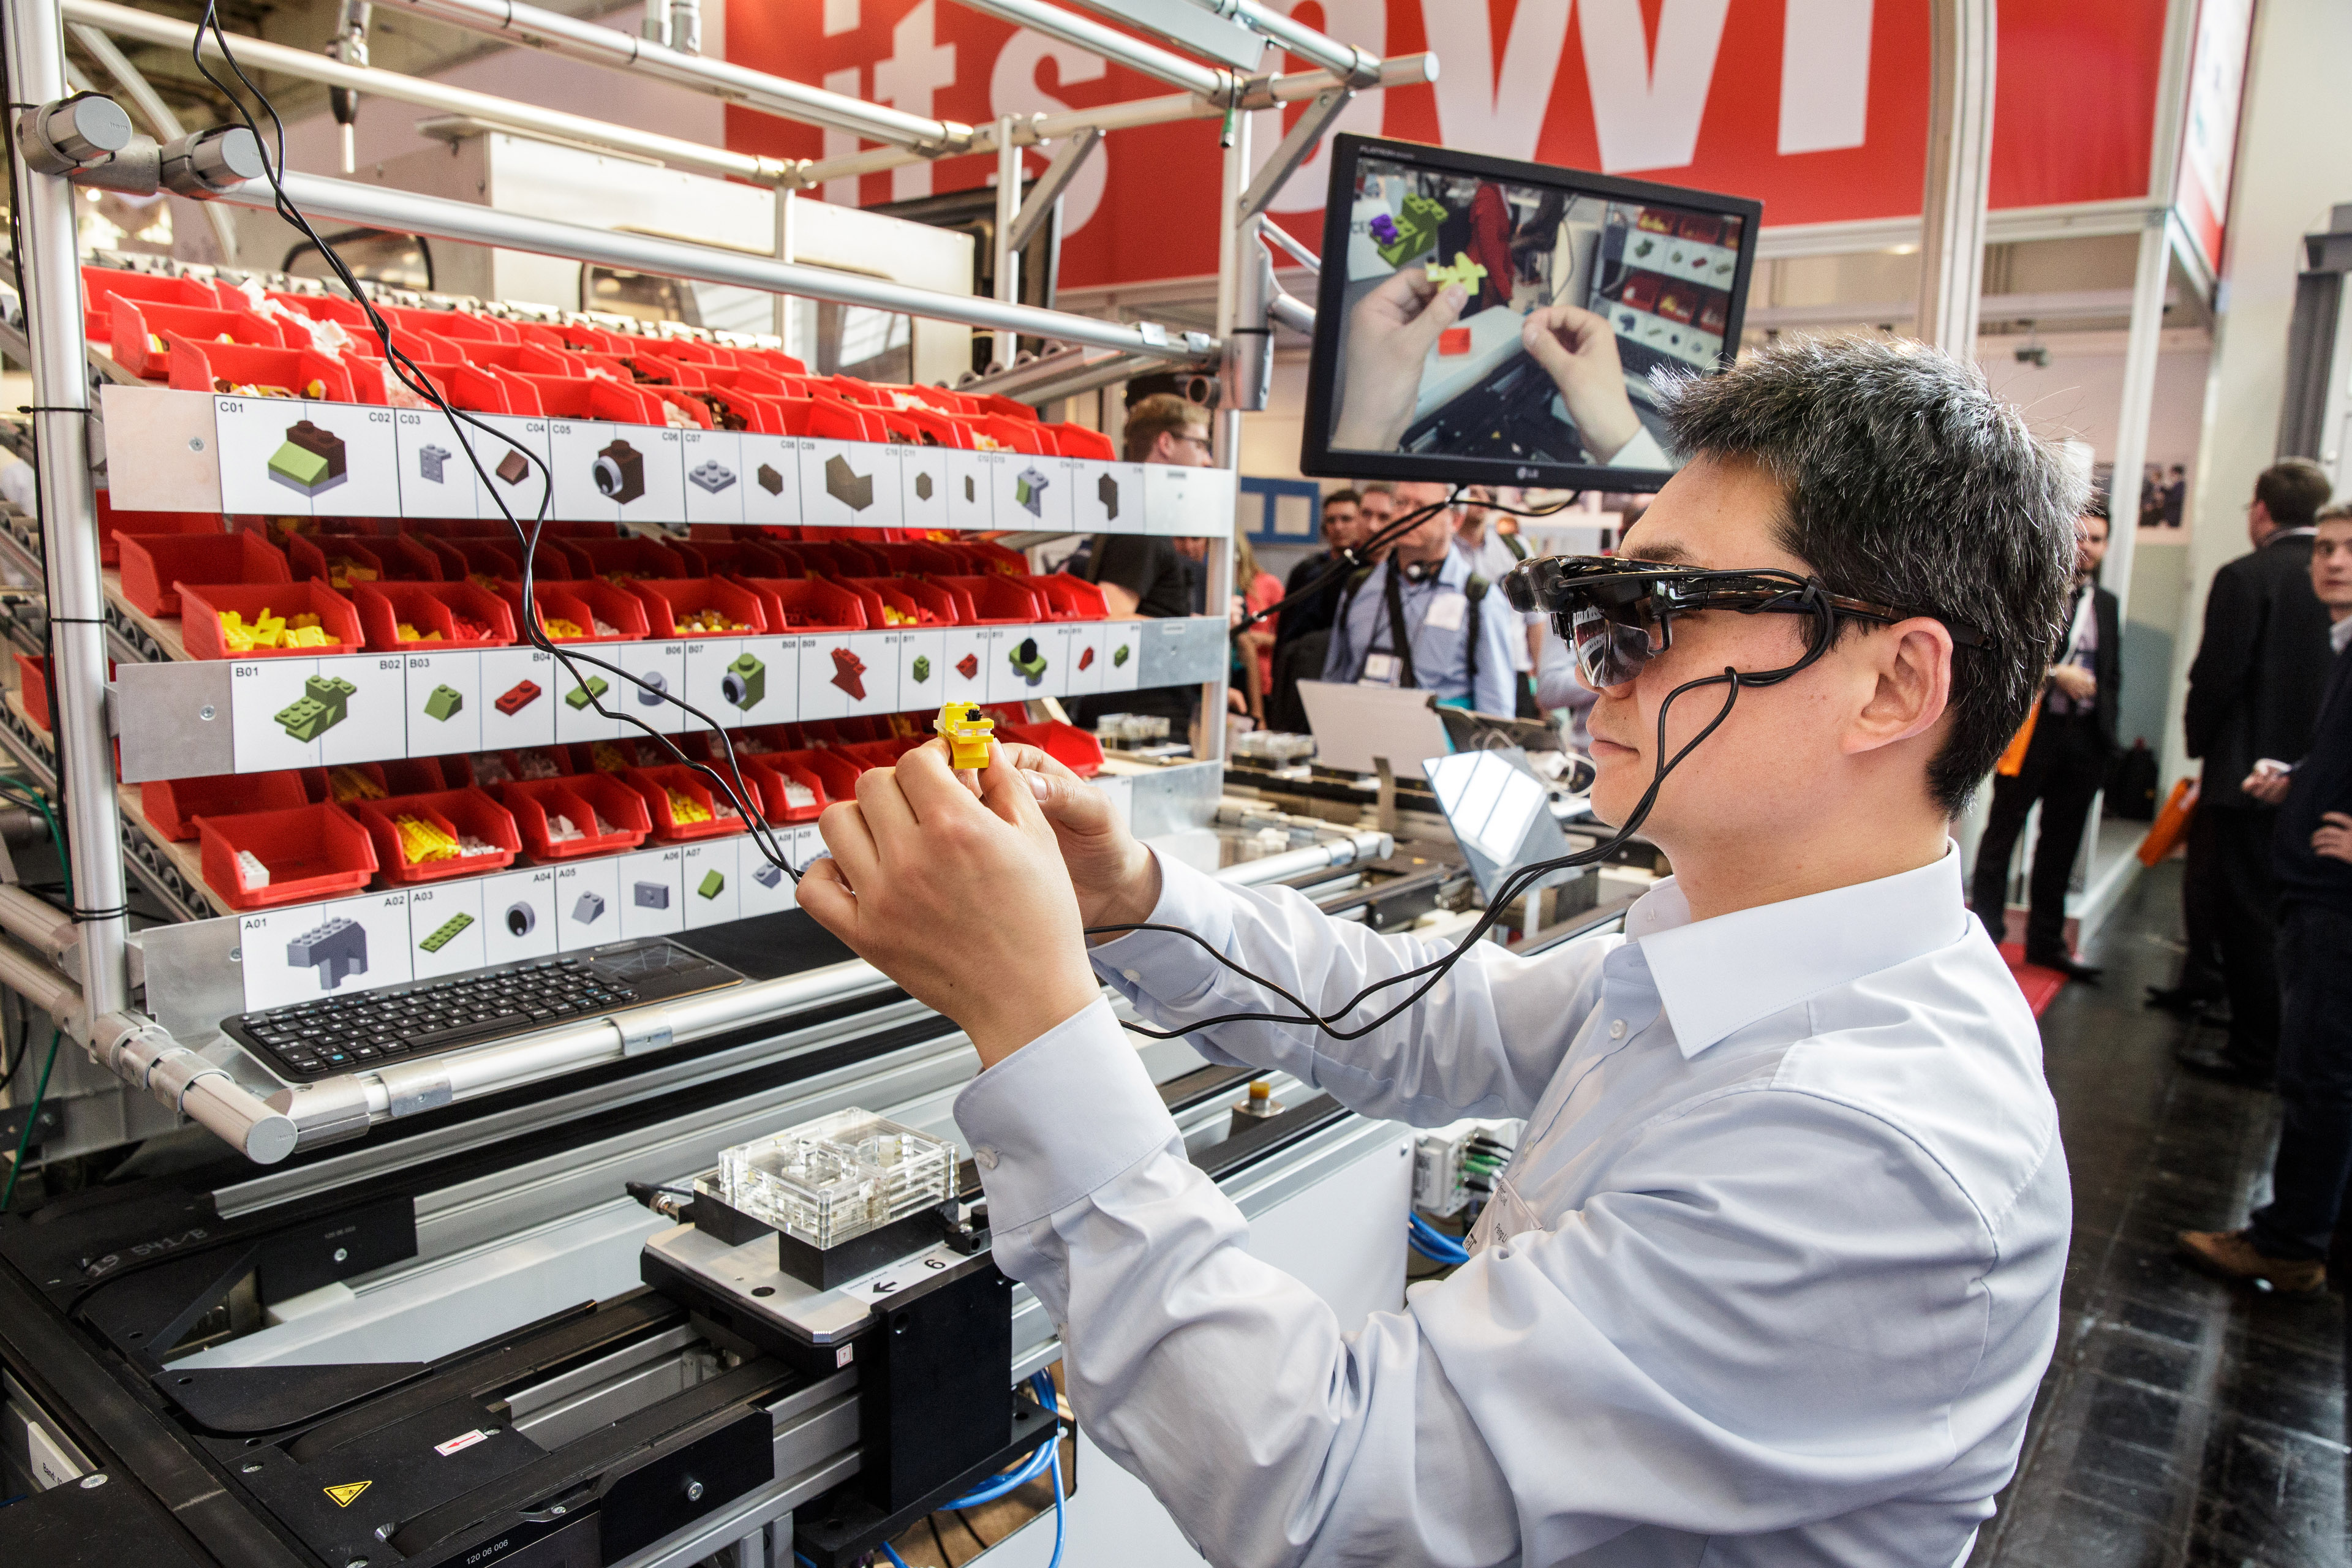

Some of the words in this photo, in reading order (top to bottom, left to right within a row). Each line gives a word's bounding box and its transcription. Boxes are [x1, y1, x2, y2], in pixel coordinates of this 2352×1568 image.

[220, 401, 244, 413] C01
[369, 412, 390, 423] C02
[399, 413, 421, 425] C03
[526, 423, 546, 432] C04
[552, 424, 571, 435] C05
[662, 432, 679, 442] C06
[685, 434, 701, 443] C07
[665, 646, 682, 655] B06
[688, 644, 704, 654] B07
[533, 652, 550, 662] B04
[380, 660, 401, 670] B02
[409, 658, 430, 668] B03
[236, 666, 258, 677] B01
[663, 850, 679, 861] A06
[685, 846, 701, 857] A07
[533, 870, 551, 882] A04
[559, 867, 576, 878] A05
[383, 896, 404, 907] A02
[413, 891, 433, 902] A03
[245, 918, 266, 929] A01
[1494, 1223, 1504, 1241] Peng
[1502, 1234, 1509, 1244] Li
[924, 1259, 946, 1270] 6
[466, 1553, 481, 1565] 120
[482, 1547, 492, 1557] 06
[494, 1539, 509, 1551] 006
